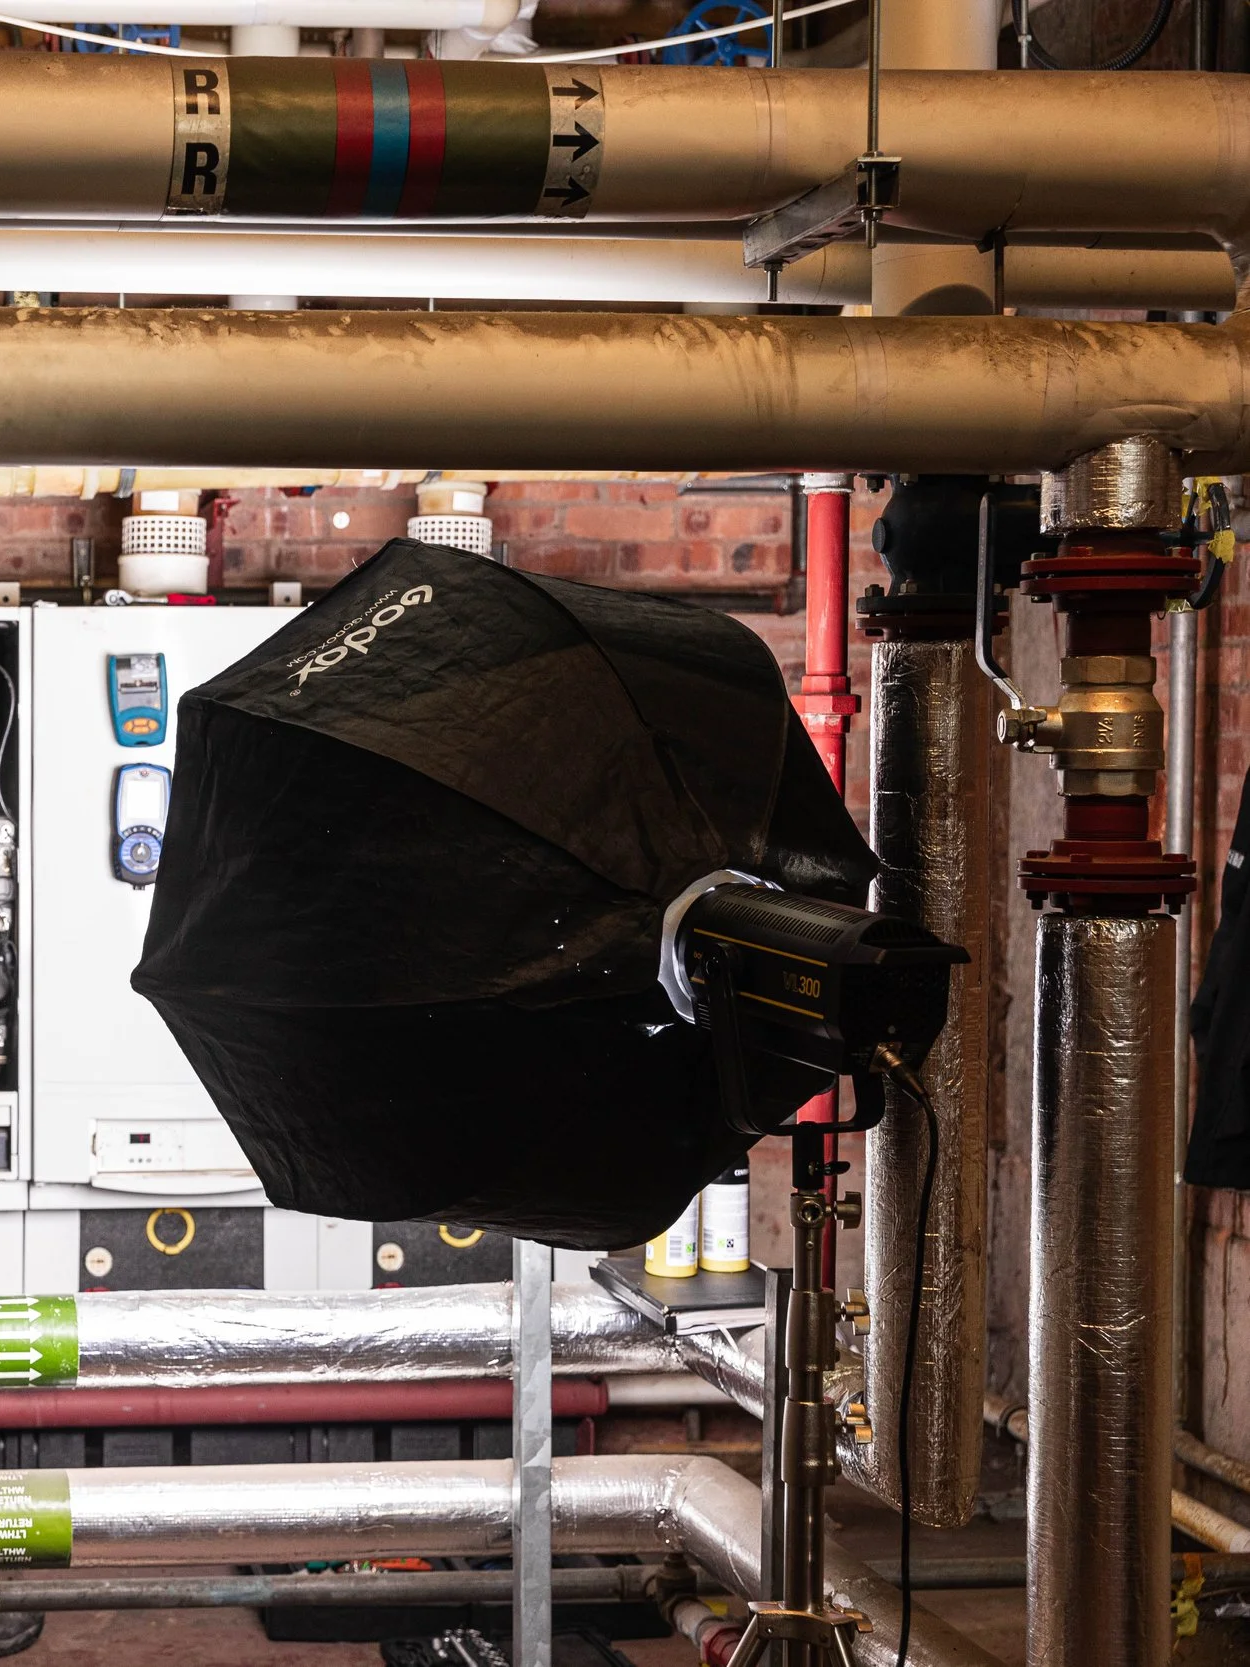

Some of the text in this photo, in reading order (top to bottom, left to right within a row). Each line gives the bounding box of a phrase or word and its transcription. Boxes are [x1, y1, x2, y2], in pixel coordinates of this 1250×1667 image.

[183, 69, 221, 114] R
[181, 143, 220, 194] R
[783, 970, 821, 999] VL300
